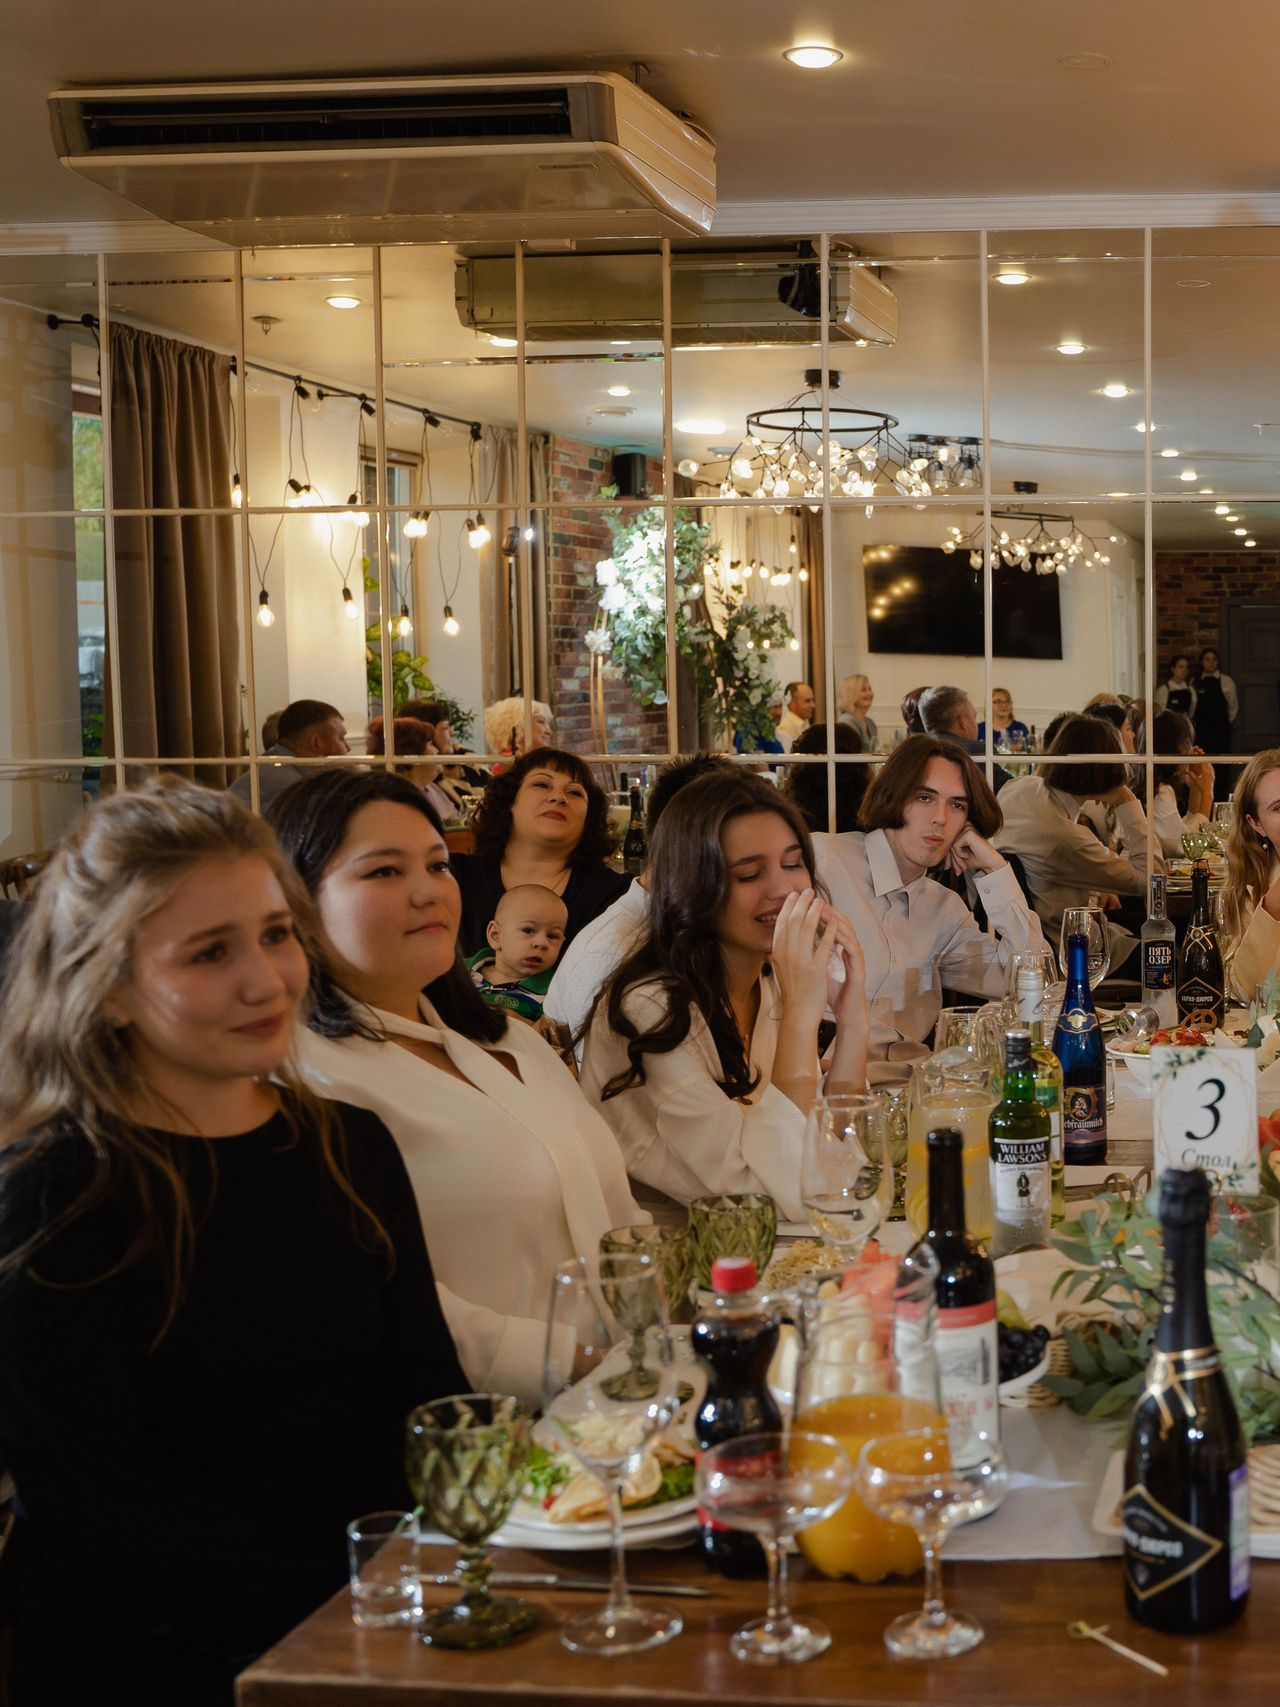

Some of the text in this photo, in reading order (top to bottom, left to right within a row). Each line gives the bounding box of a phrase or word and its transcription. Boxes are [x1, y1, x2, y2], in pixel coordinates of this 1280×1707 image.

[1148, 946, 1171, 956] ПЯТЬ
[1148, 955, 1171, 965] ОЗЕР
[1185, 1078, 1226, 1140] 3
[1000, 1143, 1045, 1154] WILLIAM
